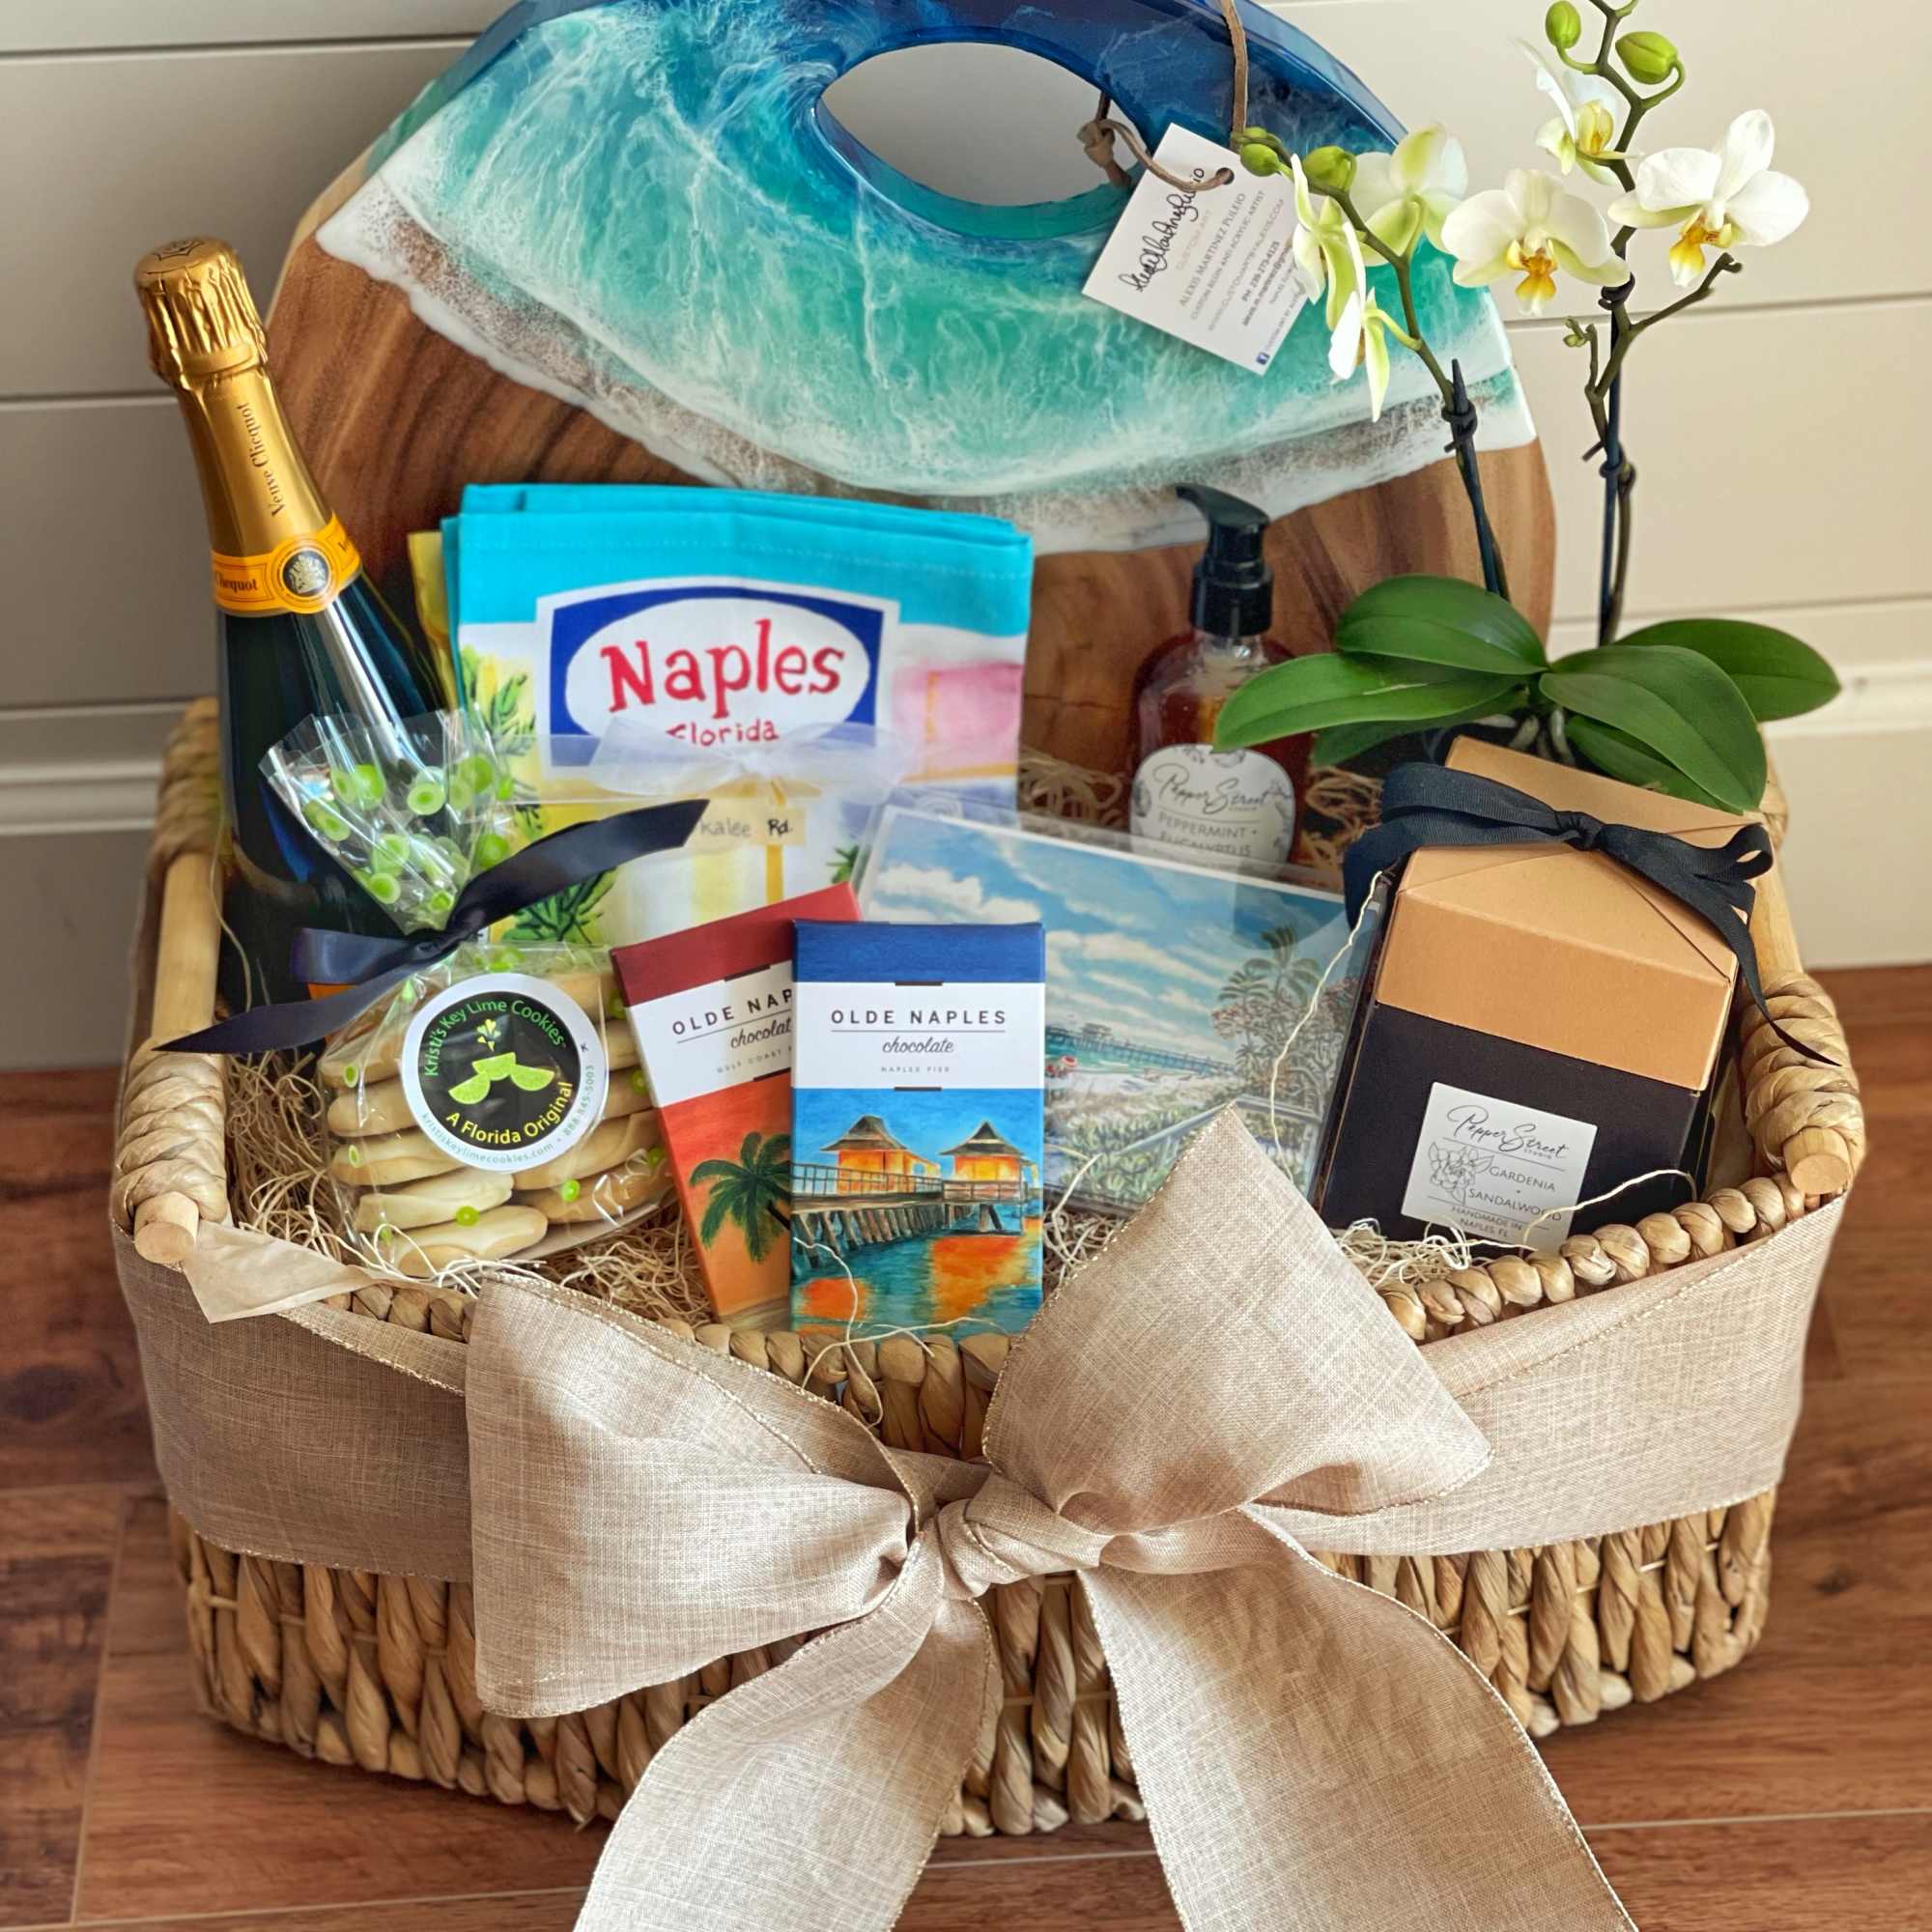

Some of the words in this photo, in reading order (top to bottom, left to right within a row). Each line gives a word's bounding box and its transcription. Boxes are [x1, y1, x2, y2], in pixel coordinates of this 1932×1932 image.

[237, 402, 270, 468] Clicquot
[263, 469, 286, 517] Veuve
[599, 618, 845, 720] Naples
[440, 1009, 468, 1029] Key
[467, 999, 508, 1015] Lime
[511, 1000, 565, 1046] Cookies
[671, 1006, 735, 1036] OLDE
[748, 988, 793, 1014] NAP
[730, 1019, 793, 1048] chocolat
[831, 1009, 896, 1025] OLDE
[909, 1009, 1007, 1025] NAPLES
[881, 1037, 954, 1055] chocolate
[445, 1112, 461, 1126] A
[461, 1121, 522, 1145] Florida
[524, 1081, 573, 1137] Original
[1490, 1165, 1556, 1192] GARDENIA
[1452, 1205, 1510, 1228] HANDMADE
